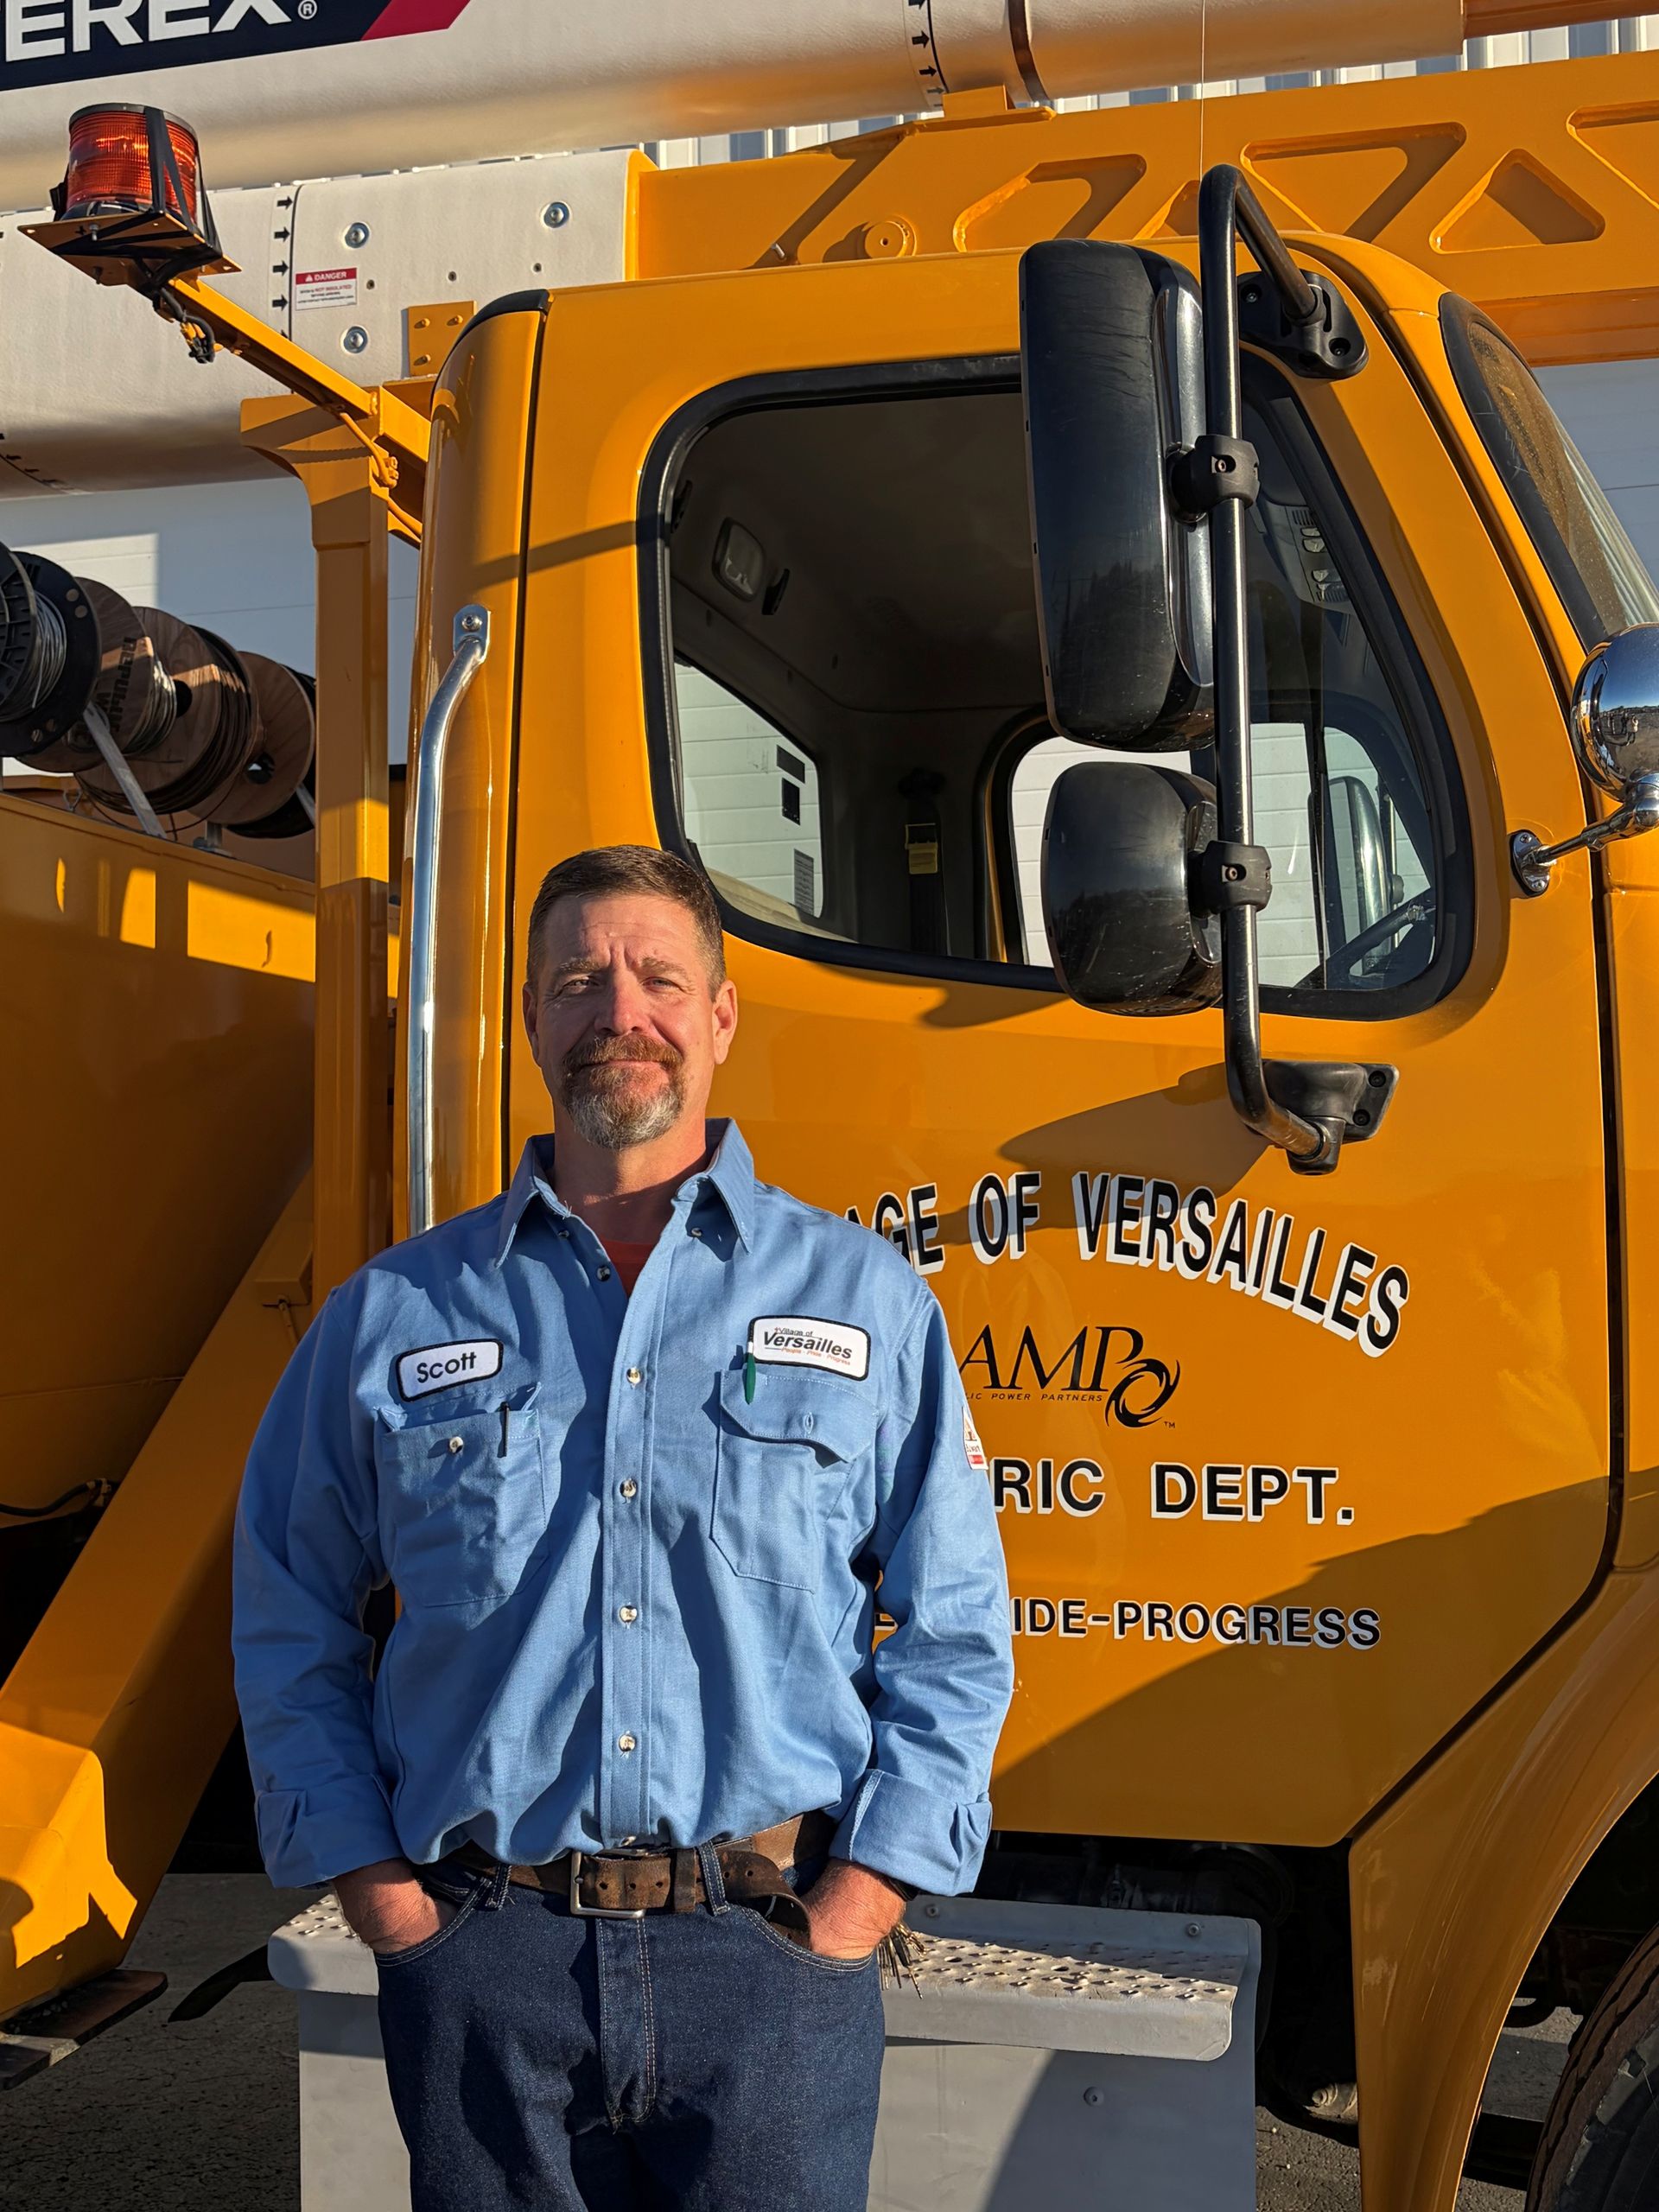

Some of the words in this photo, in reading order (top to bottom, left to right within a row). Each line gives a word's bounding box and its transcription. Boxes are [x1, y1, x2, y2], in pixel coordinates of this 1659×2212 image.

[0, 0, 292, 62] ERE
[314, 271, 347, 281] DANGER
[969, 1171, 1042, 1265] OF
[1071, 1171, 1410, 1358] VERSAILLES
[416, 1351, 477, 1383] Scott
[764, 1332, 853, 1359] Versailles
[959, 1324, 1144, 1392] AMP
[990, 1457, 1105, 1517] RIC
[1150, 1461, 1356, 1526] DEPT.
[1009, 1597, 1382, 1651] IDE-PROGRESS
